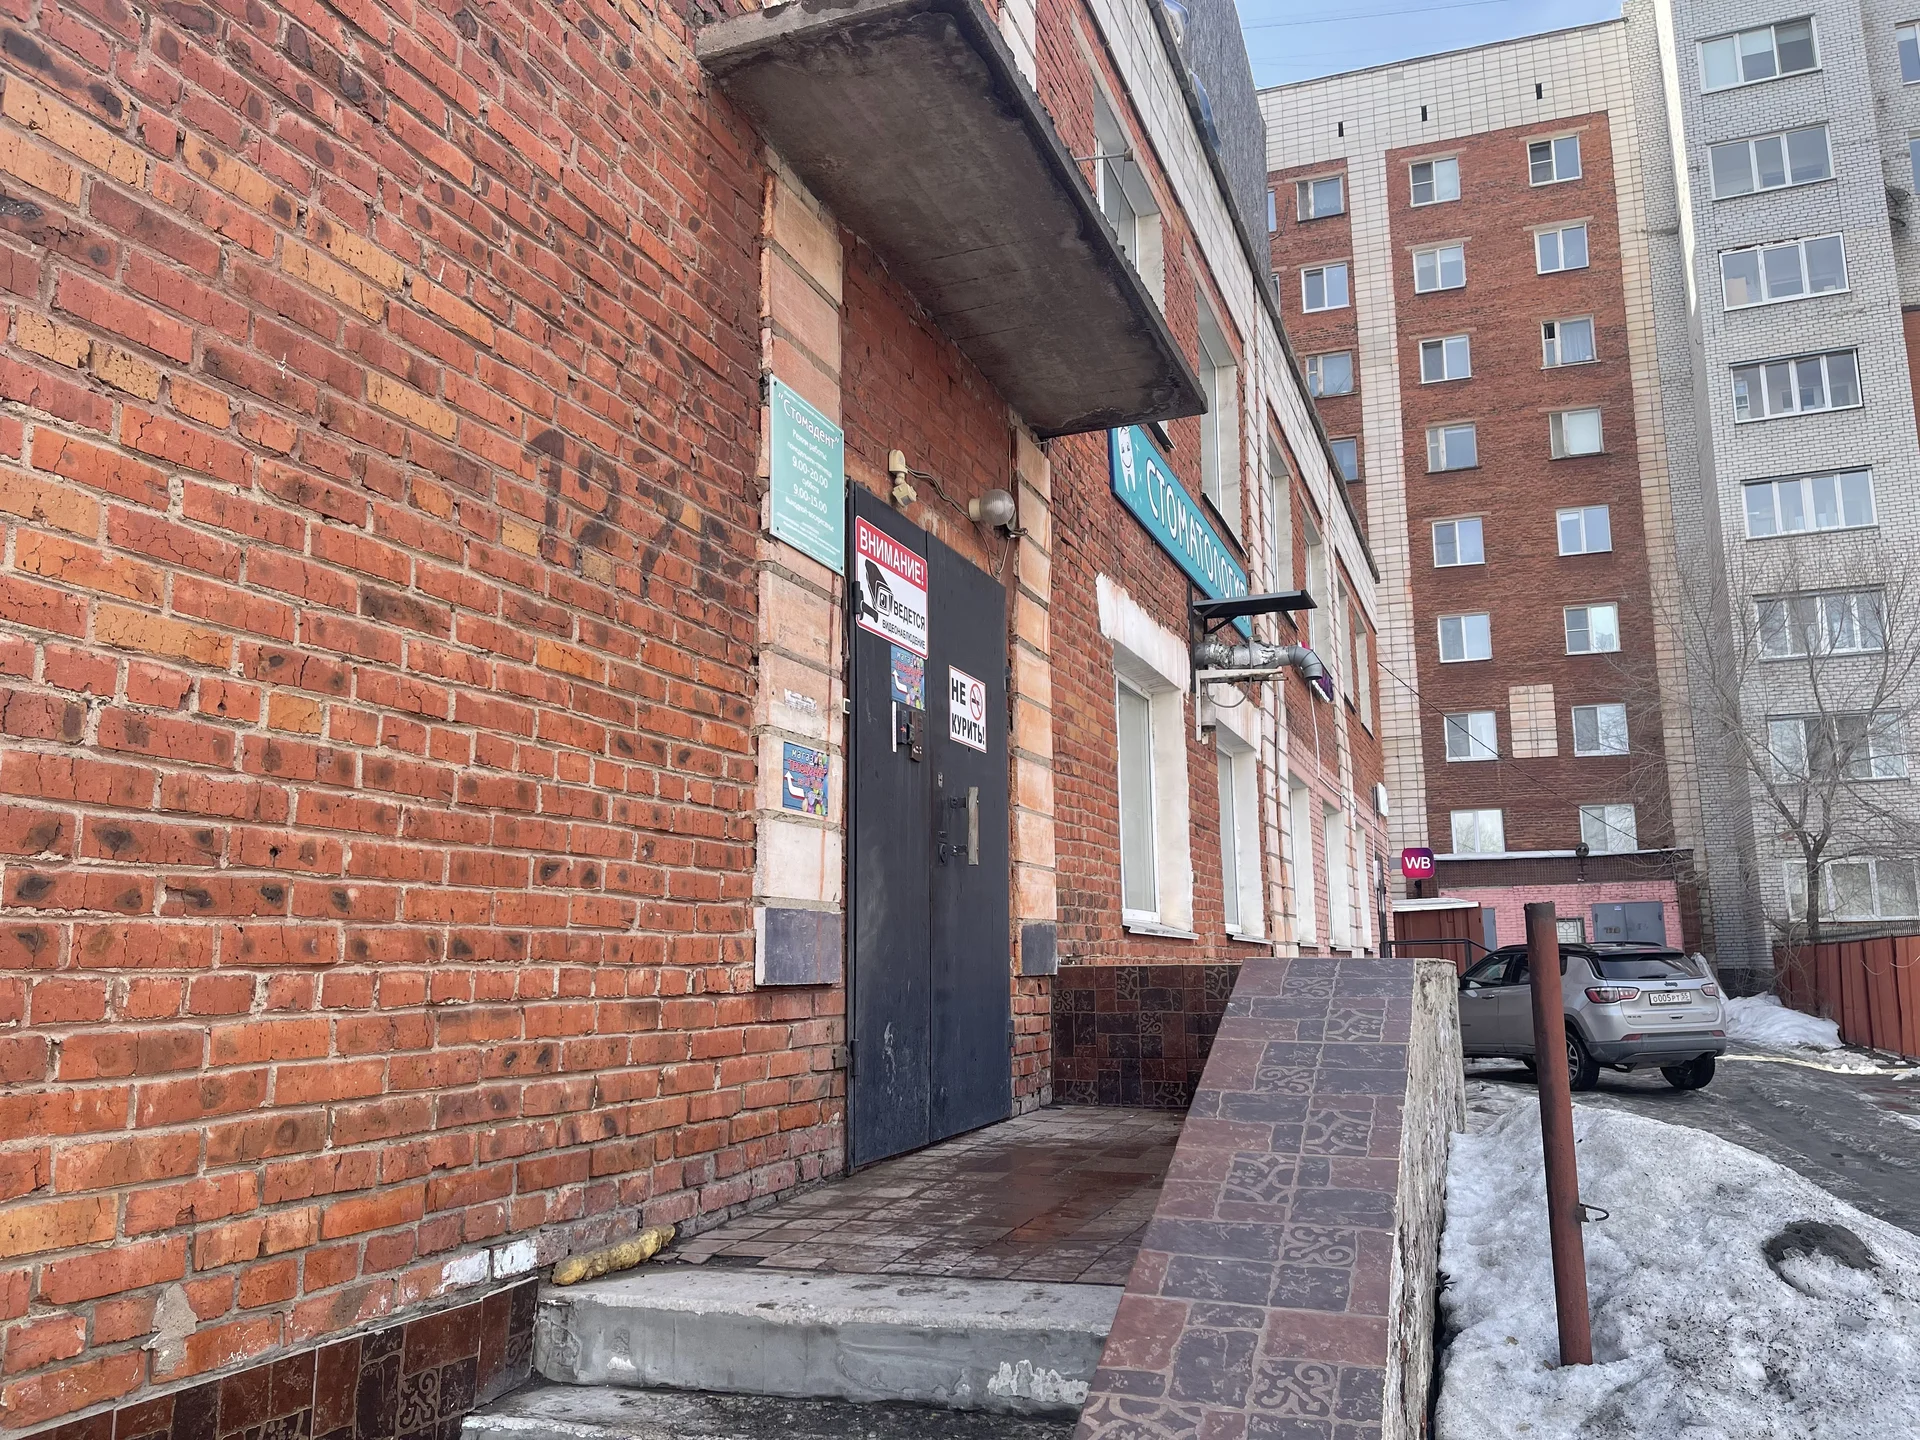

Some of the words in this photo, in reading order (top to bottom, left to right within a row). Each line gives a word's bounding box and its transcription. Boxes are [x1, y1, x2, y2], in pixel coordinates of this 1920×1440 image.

[792, 455, 829, 489] 9.00-20.00
[859, 525, 925, 586] ВНИМАНИЕ!
[893, 600, 926, 632] ВЕДЕТСЯ
[882, 619, 926, 650] ВИДЕОНАБЛЮДЕНИЕ
[951, 677, 966, 706] НЕ
[951, 712, 986, 746] КУРИТЬ!
[1404, 856, 1431, 869] WB
